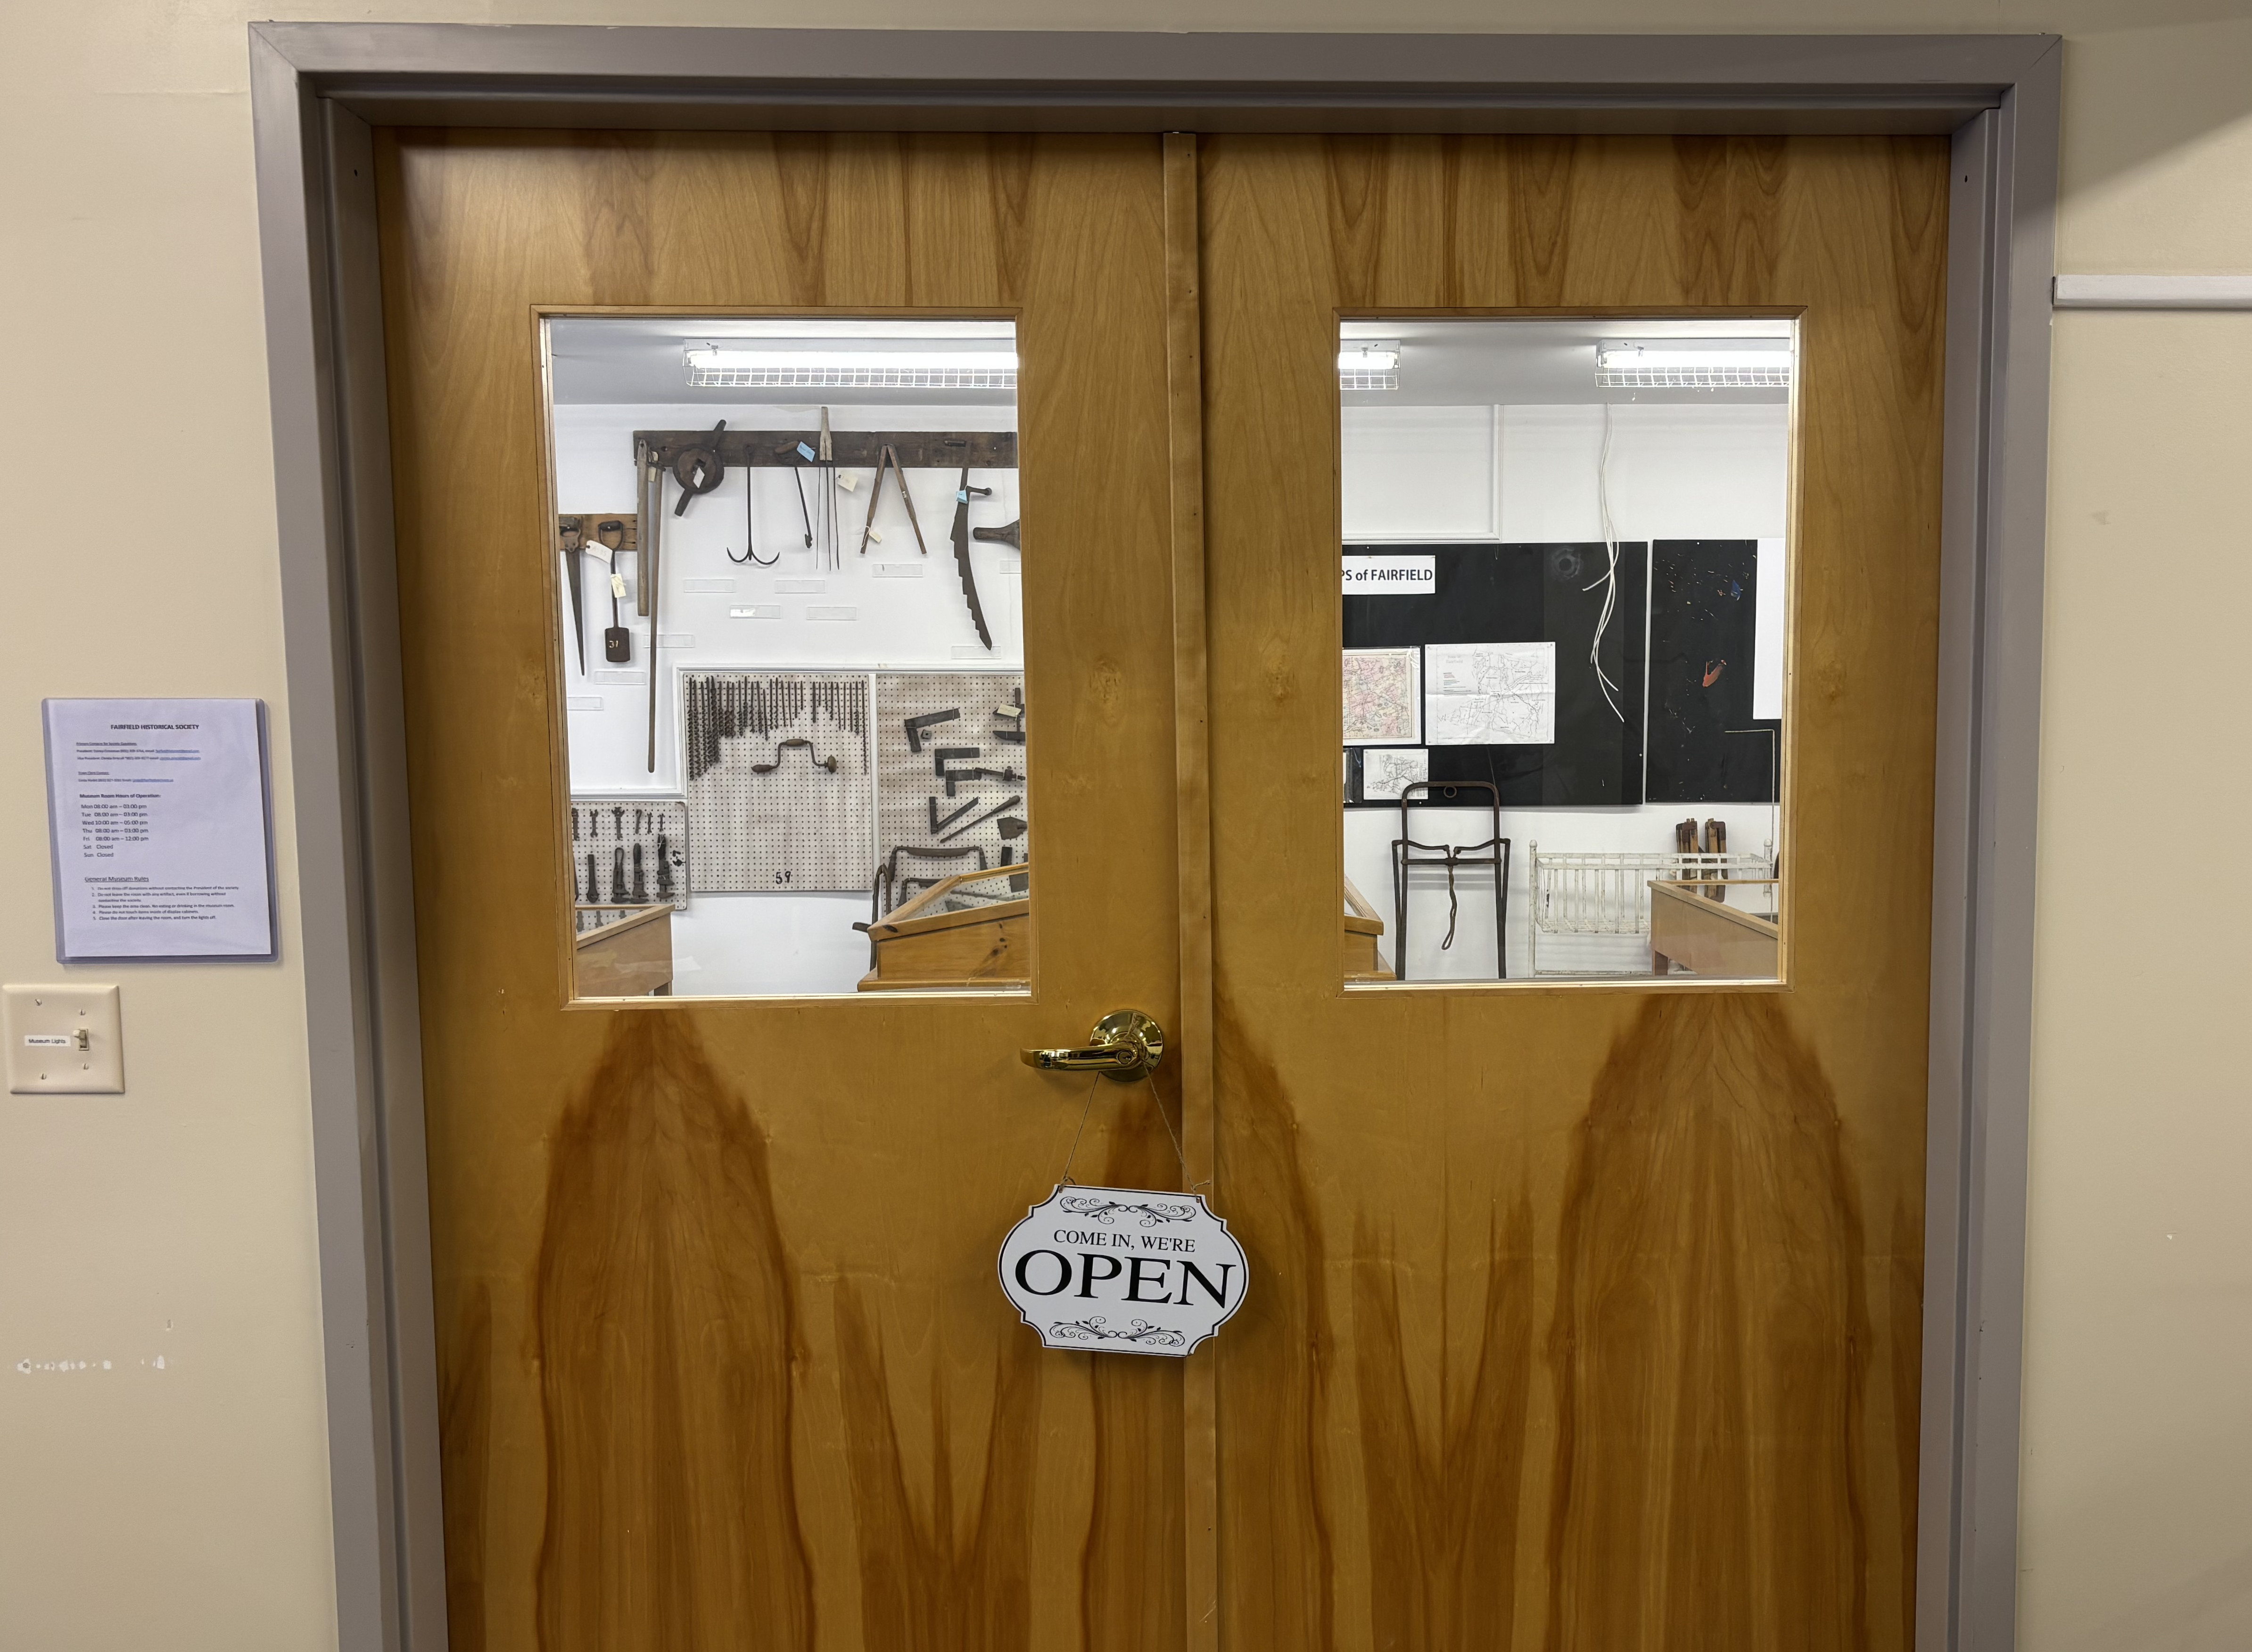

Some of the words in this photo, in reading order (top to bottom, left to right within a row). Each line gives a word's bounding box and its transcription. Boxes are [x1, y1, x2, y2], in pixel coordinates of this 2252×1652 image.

[1355, 569, 1368, 581] of
[1371, 569, 1433, 581] FAIRFIELD
[609, 640, 619, 648] 31
[775, 871, 791, 884] 59
[1054, 1229, 1107, 1246] COME
[1111, 1233, 1135, 1250] IN,
[1141, 1235, 1196, 1252] WE'RE
[1015, 1249, 1237, 1309] OPEN
